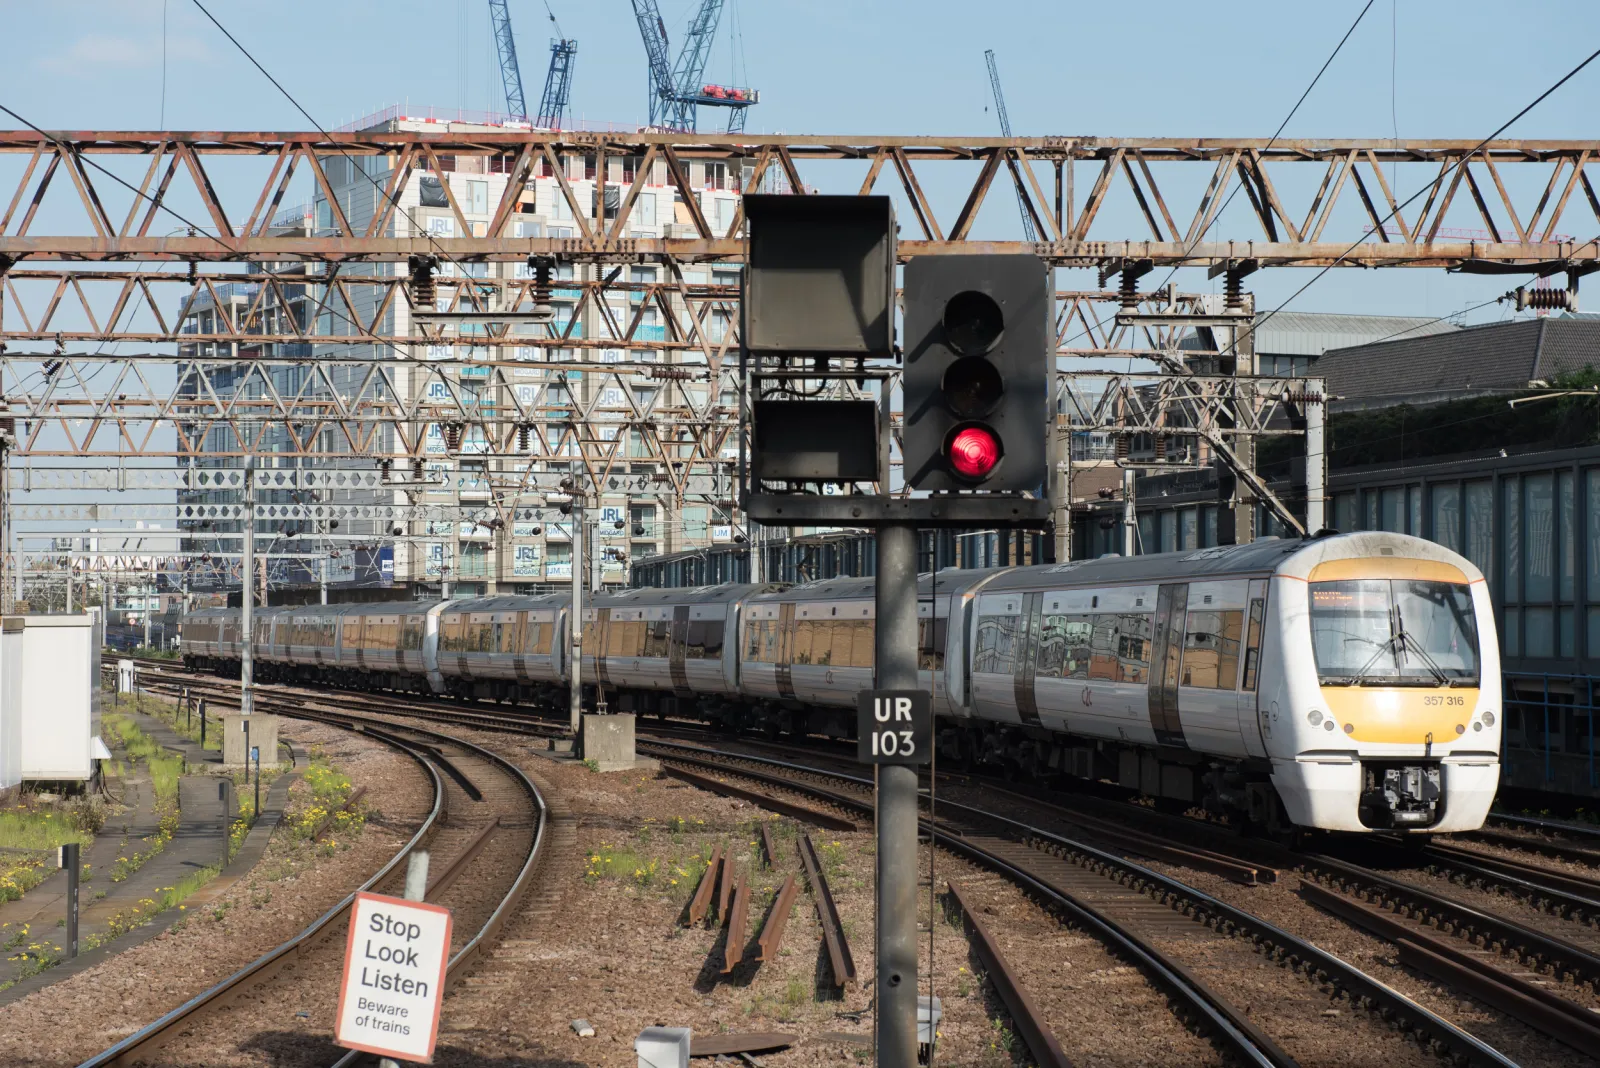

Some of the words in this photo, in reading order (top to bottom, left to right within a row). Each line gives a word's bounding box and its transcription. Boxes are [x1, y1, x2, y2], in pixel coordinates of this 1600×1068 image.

[429, 218, 452, 232] JRL
[428, 344, 452, 356] JRL
[516, 347, 539, 360] JRL
[428, 383, 452, 397] JRL
[601, 390, 624, 403] JRL
[601, 508, 624, 521] JRL
[714, 529, 728, 537] IJM
[516, 547, 539, 560] JRL
[1424, 696, 1444, 706] 357
[1446, 696, 1464, 706] 316
[874, 697, 913, 722] UR
[872, 730, 916, 757] 103
[369, 912, 421, 942] Stop
[365, 939, 419, 968] Look
[361, 966, 428, 998] Listen
[357, 997, 409, 1018] Beware
[355, 1015, 371, 1028] of
[372, 1017, 411, 1036] trains
